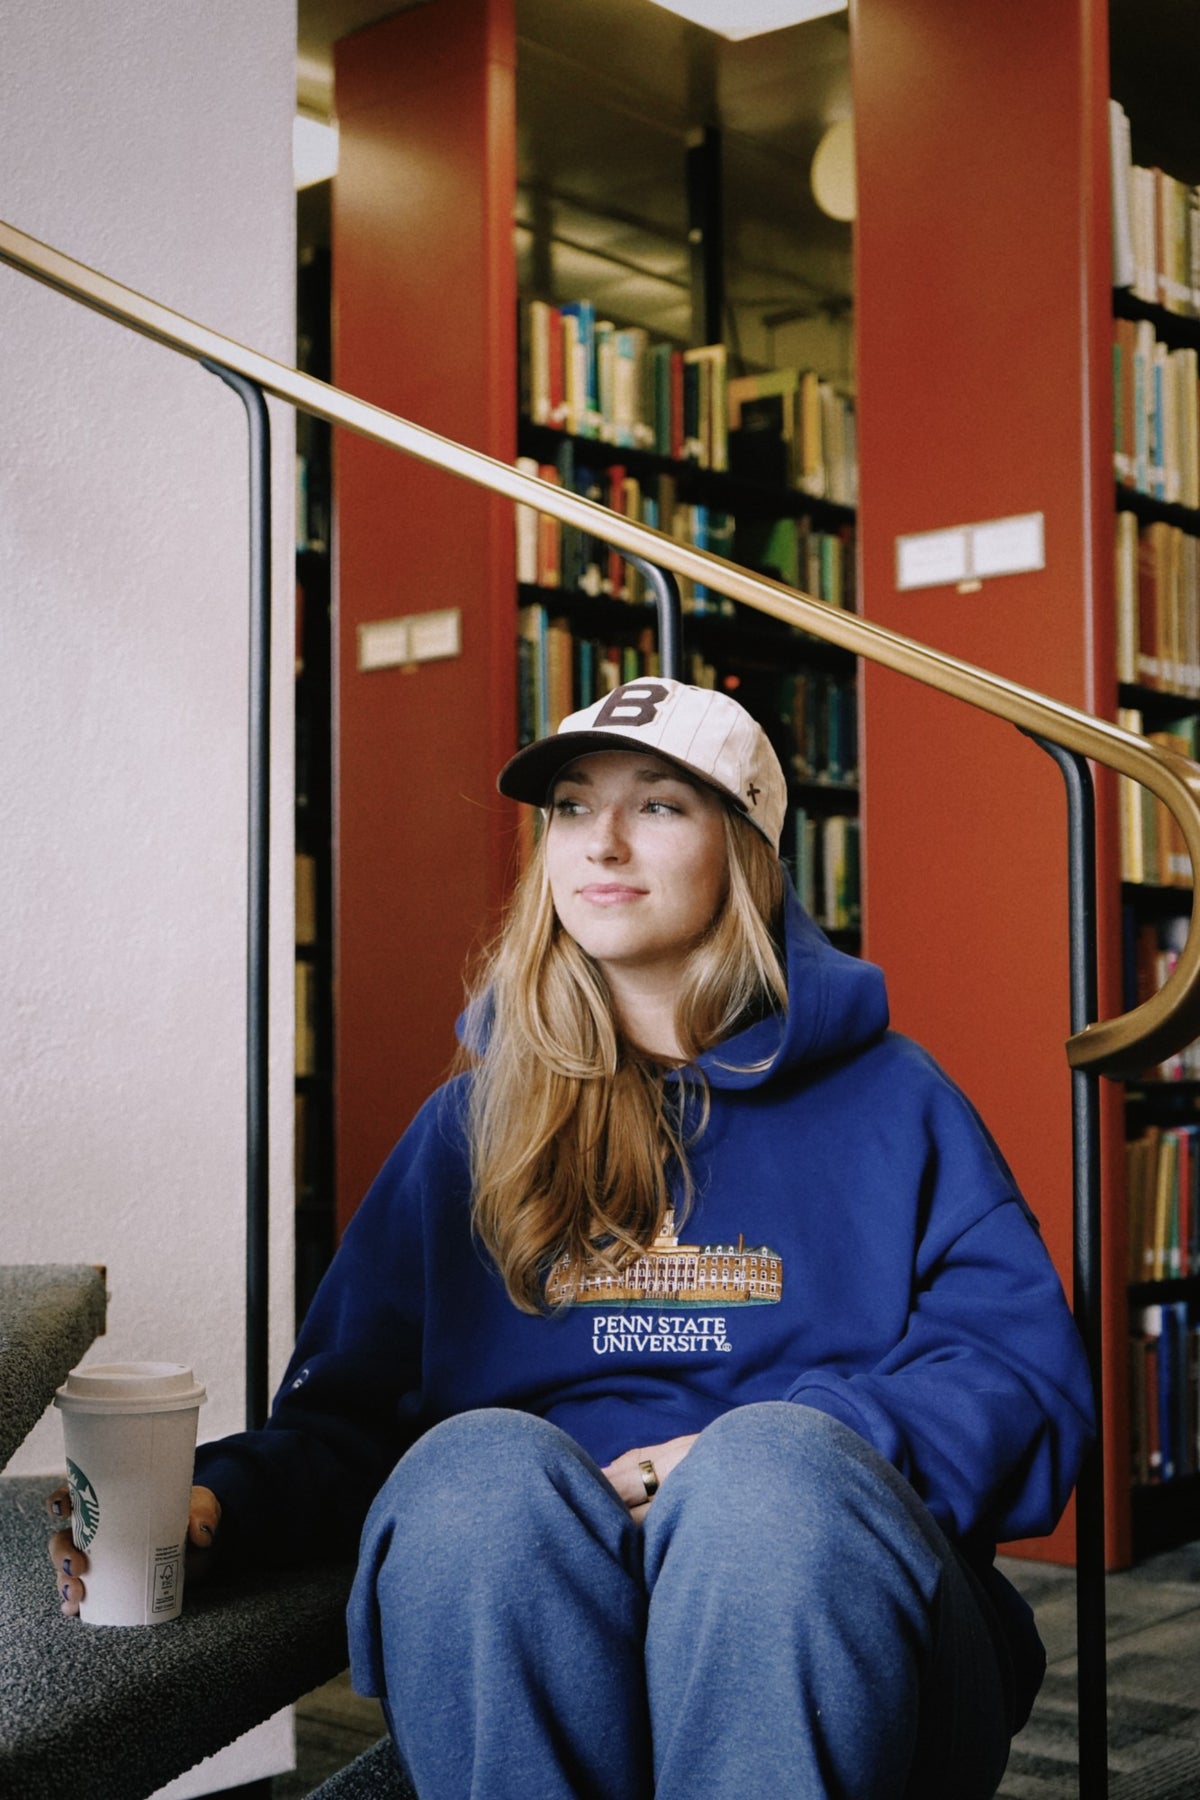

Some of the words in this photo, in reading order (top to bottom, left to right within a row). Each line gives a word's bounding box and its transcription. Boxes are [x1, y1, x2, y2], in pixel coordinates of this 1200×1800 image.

[592, 684, 670, 727] B
[593, 1316, 653, 1334] PENN
[658, 1317, 727, 1334] STATE
